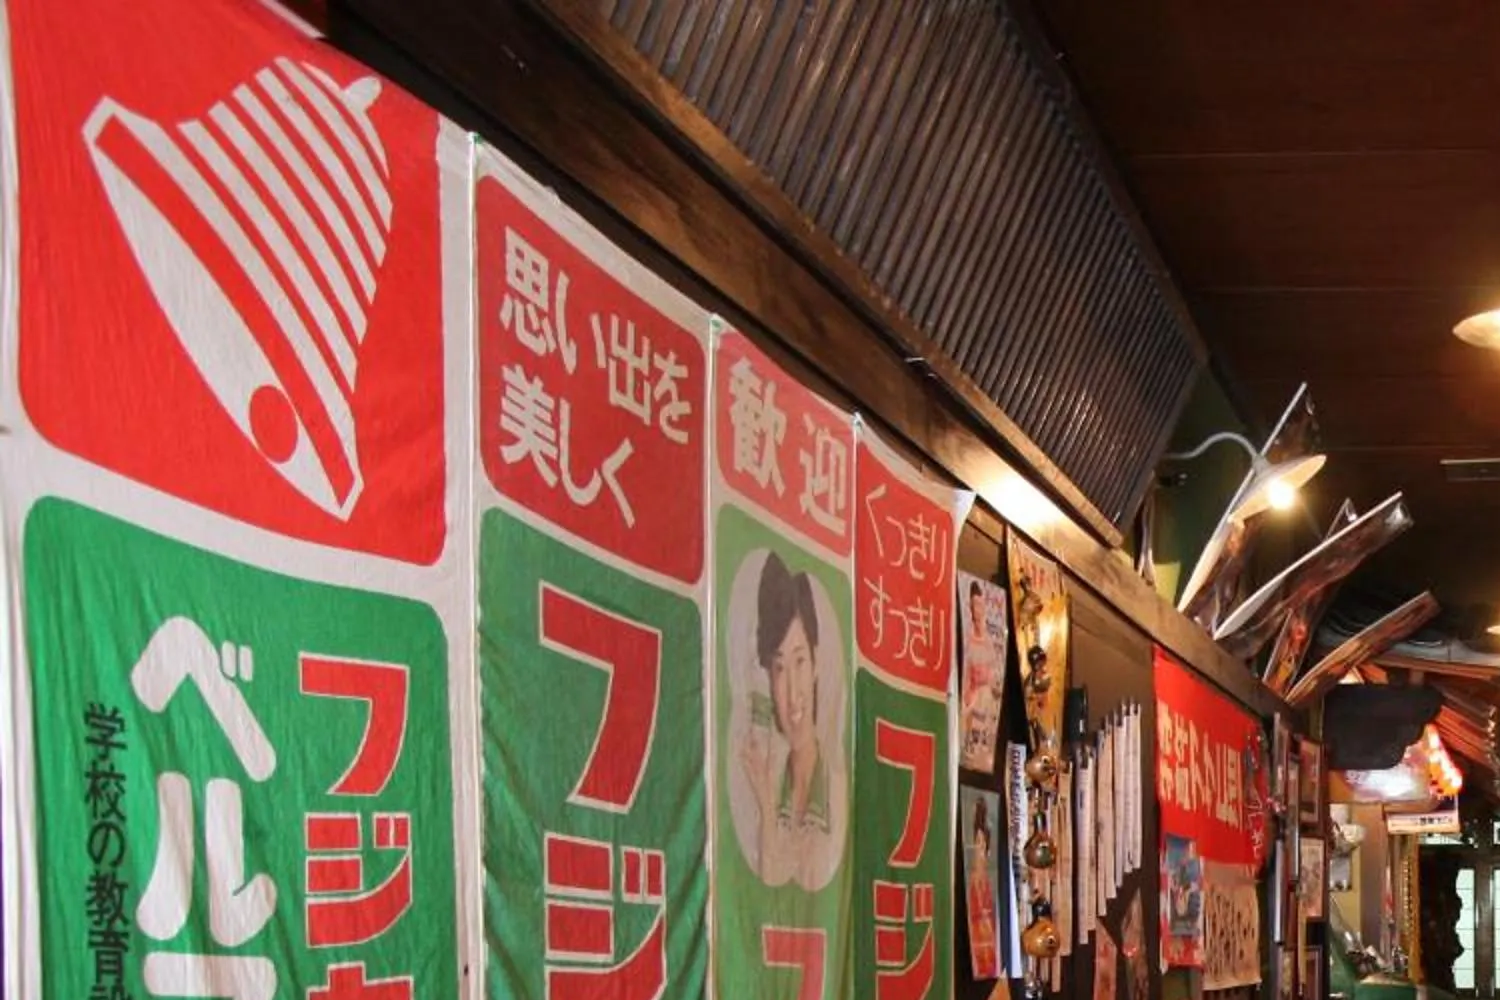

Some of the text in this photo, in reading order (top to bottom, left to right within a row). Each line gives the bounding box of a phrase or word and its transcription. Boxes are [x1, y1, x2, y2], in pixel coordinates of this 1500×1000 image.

[498, 226, 691, 447] 思い出を
[498, 363, 638, 528] 美しく
[726, 355, 851, 540] 歓迎
[866, 483, 948, 589] くっきり
[867, 575, 948, 672] すっきり
